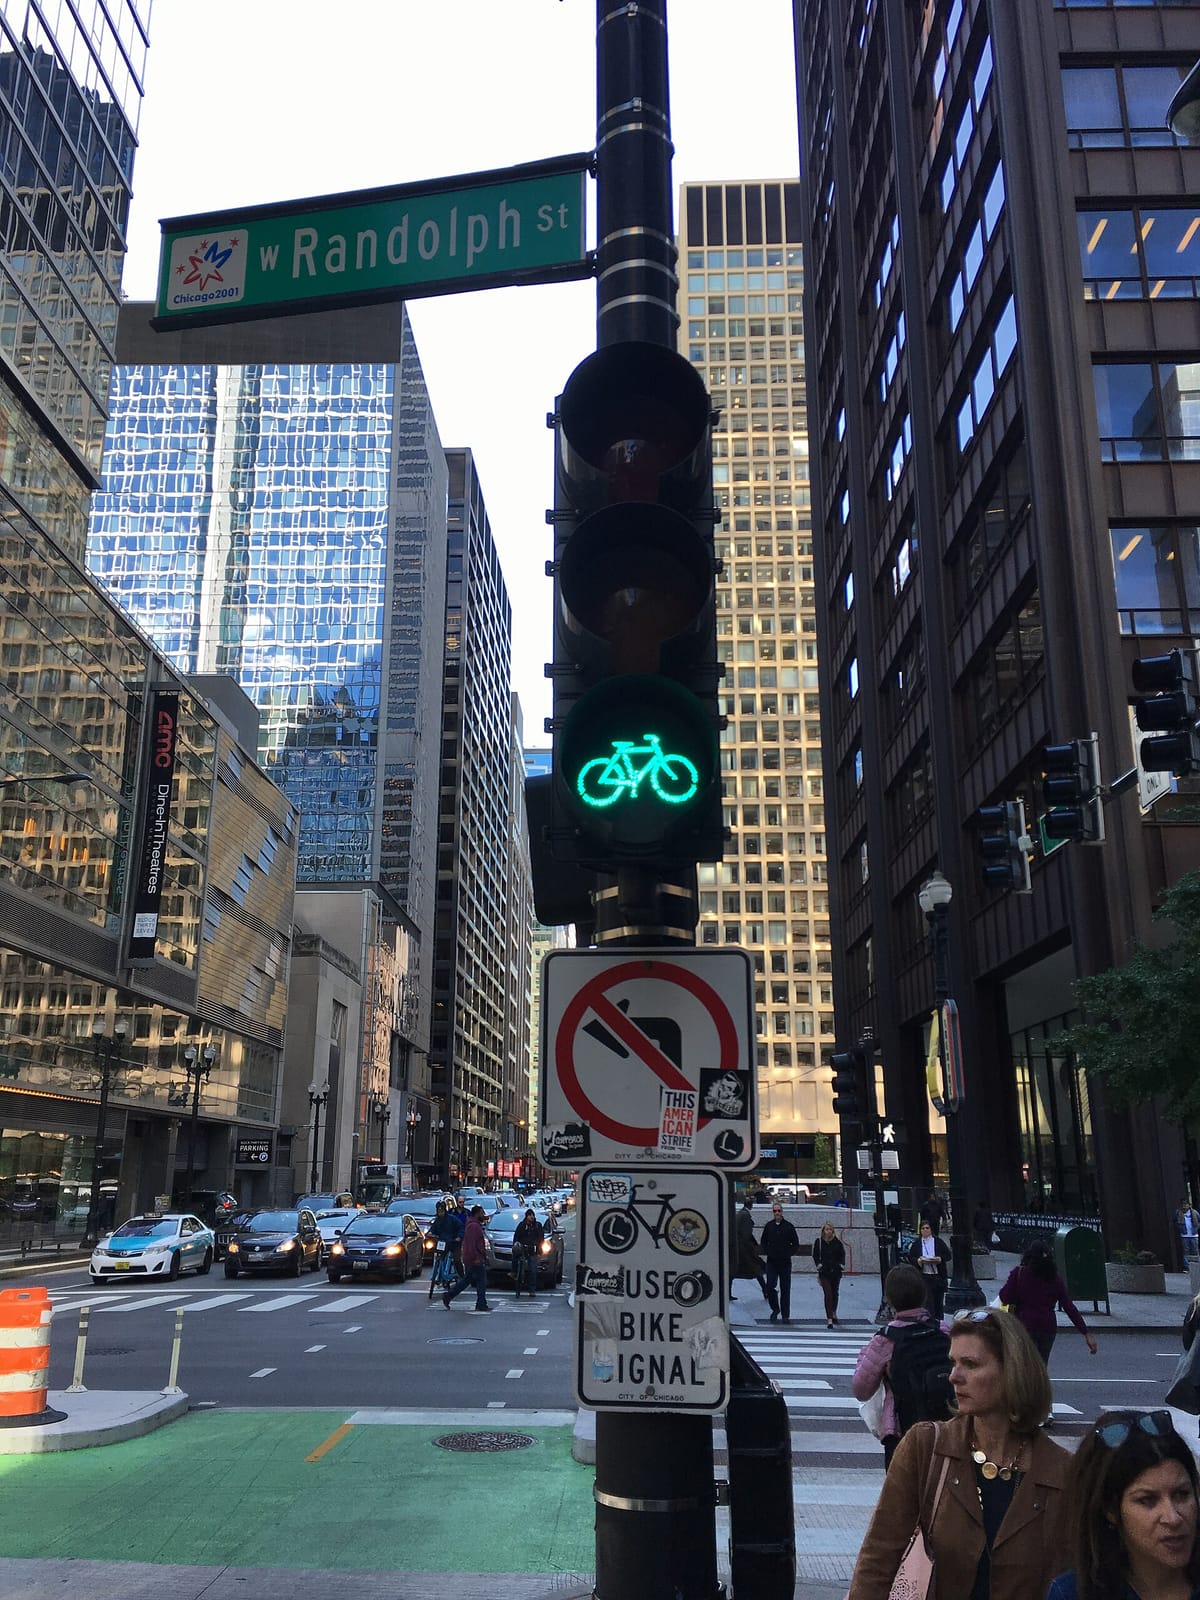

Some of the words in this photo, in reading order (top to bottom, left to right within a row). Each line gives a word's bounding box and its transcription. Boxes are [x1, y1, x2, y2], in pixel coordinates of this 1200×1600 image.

[292, 199, 521, 279] Randolph
[536, 202, 569, 232] St
[172, 286, 240, 305] Chicago2001
[1146, 773, 1162, 795] ONLY
[665, 1092, 695, 1108] THIS
[664, 1108, 694, 1121] AMER
[662, 1120, 693, 1136] ICAN
[661, 1135, 692, 1147] STRIFE
[626, 1269, 678, 1300] USE
[620, 1312, 684, 1343] BIKE
[601, 1353, 705, 1387] IGNAL
